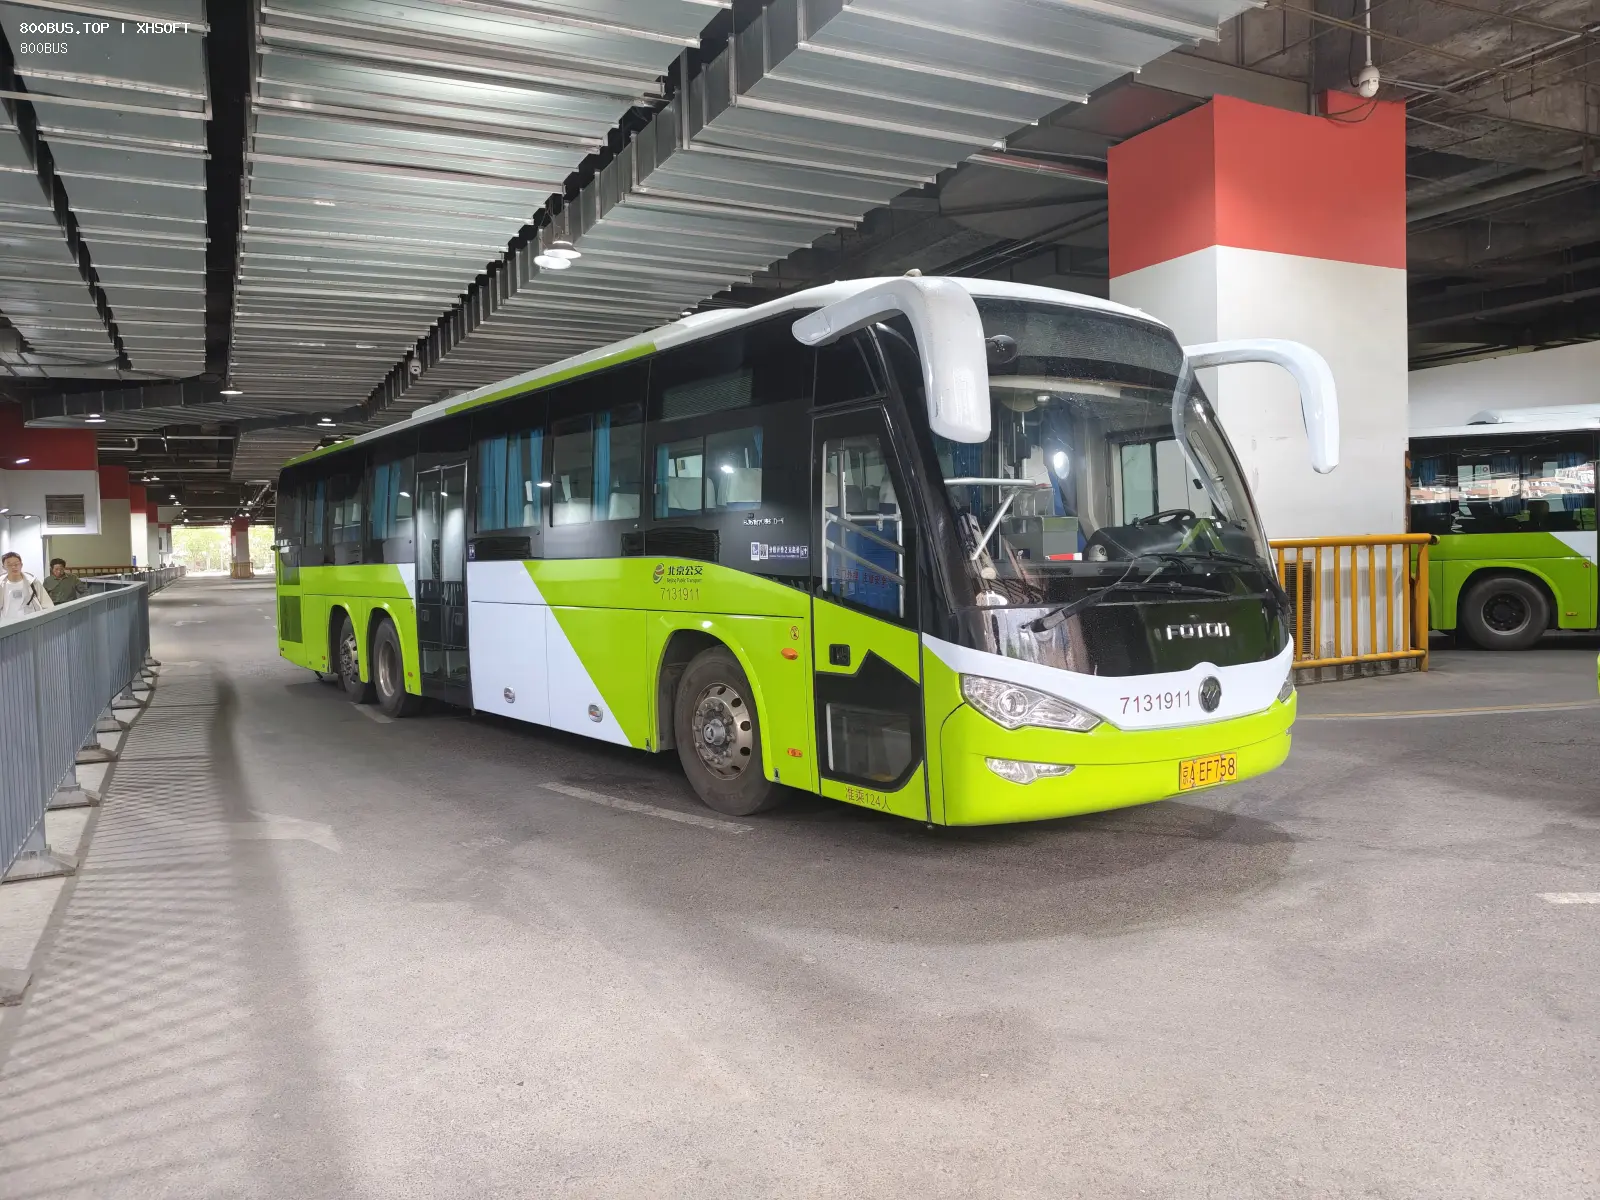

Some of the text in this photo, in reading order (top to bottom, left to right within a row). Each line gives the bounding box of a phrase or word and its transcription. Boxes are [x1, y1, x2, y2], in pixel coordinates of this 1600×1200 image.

[667, 565, 704, 576] 北京公交
[660, 587, 700, 601] 7131911
[1120, 690, 1191, 715] 7131911
[845, 785, 892, 812] 准乘124人
